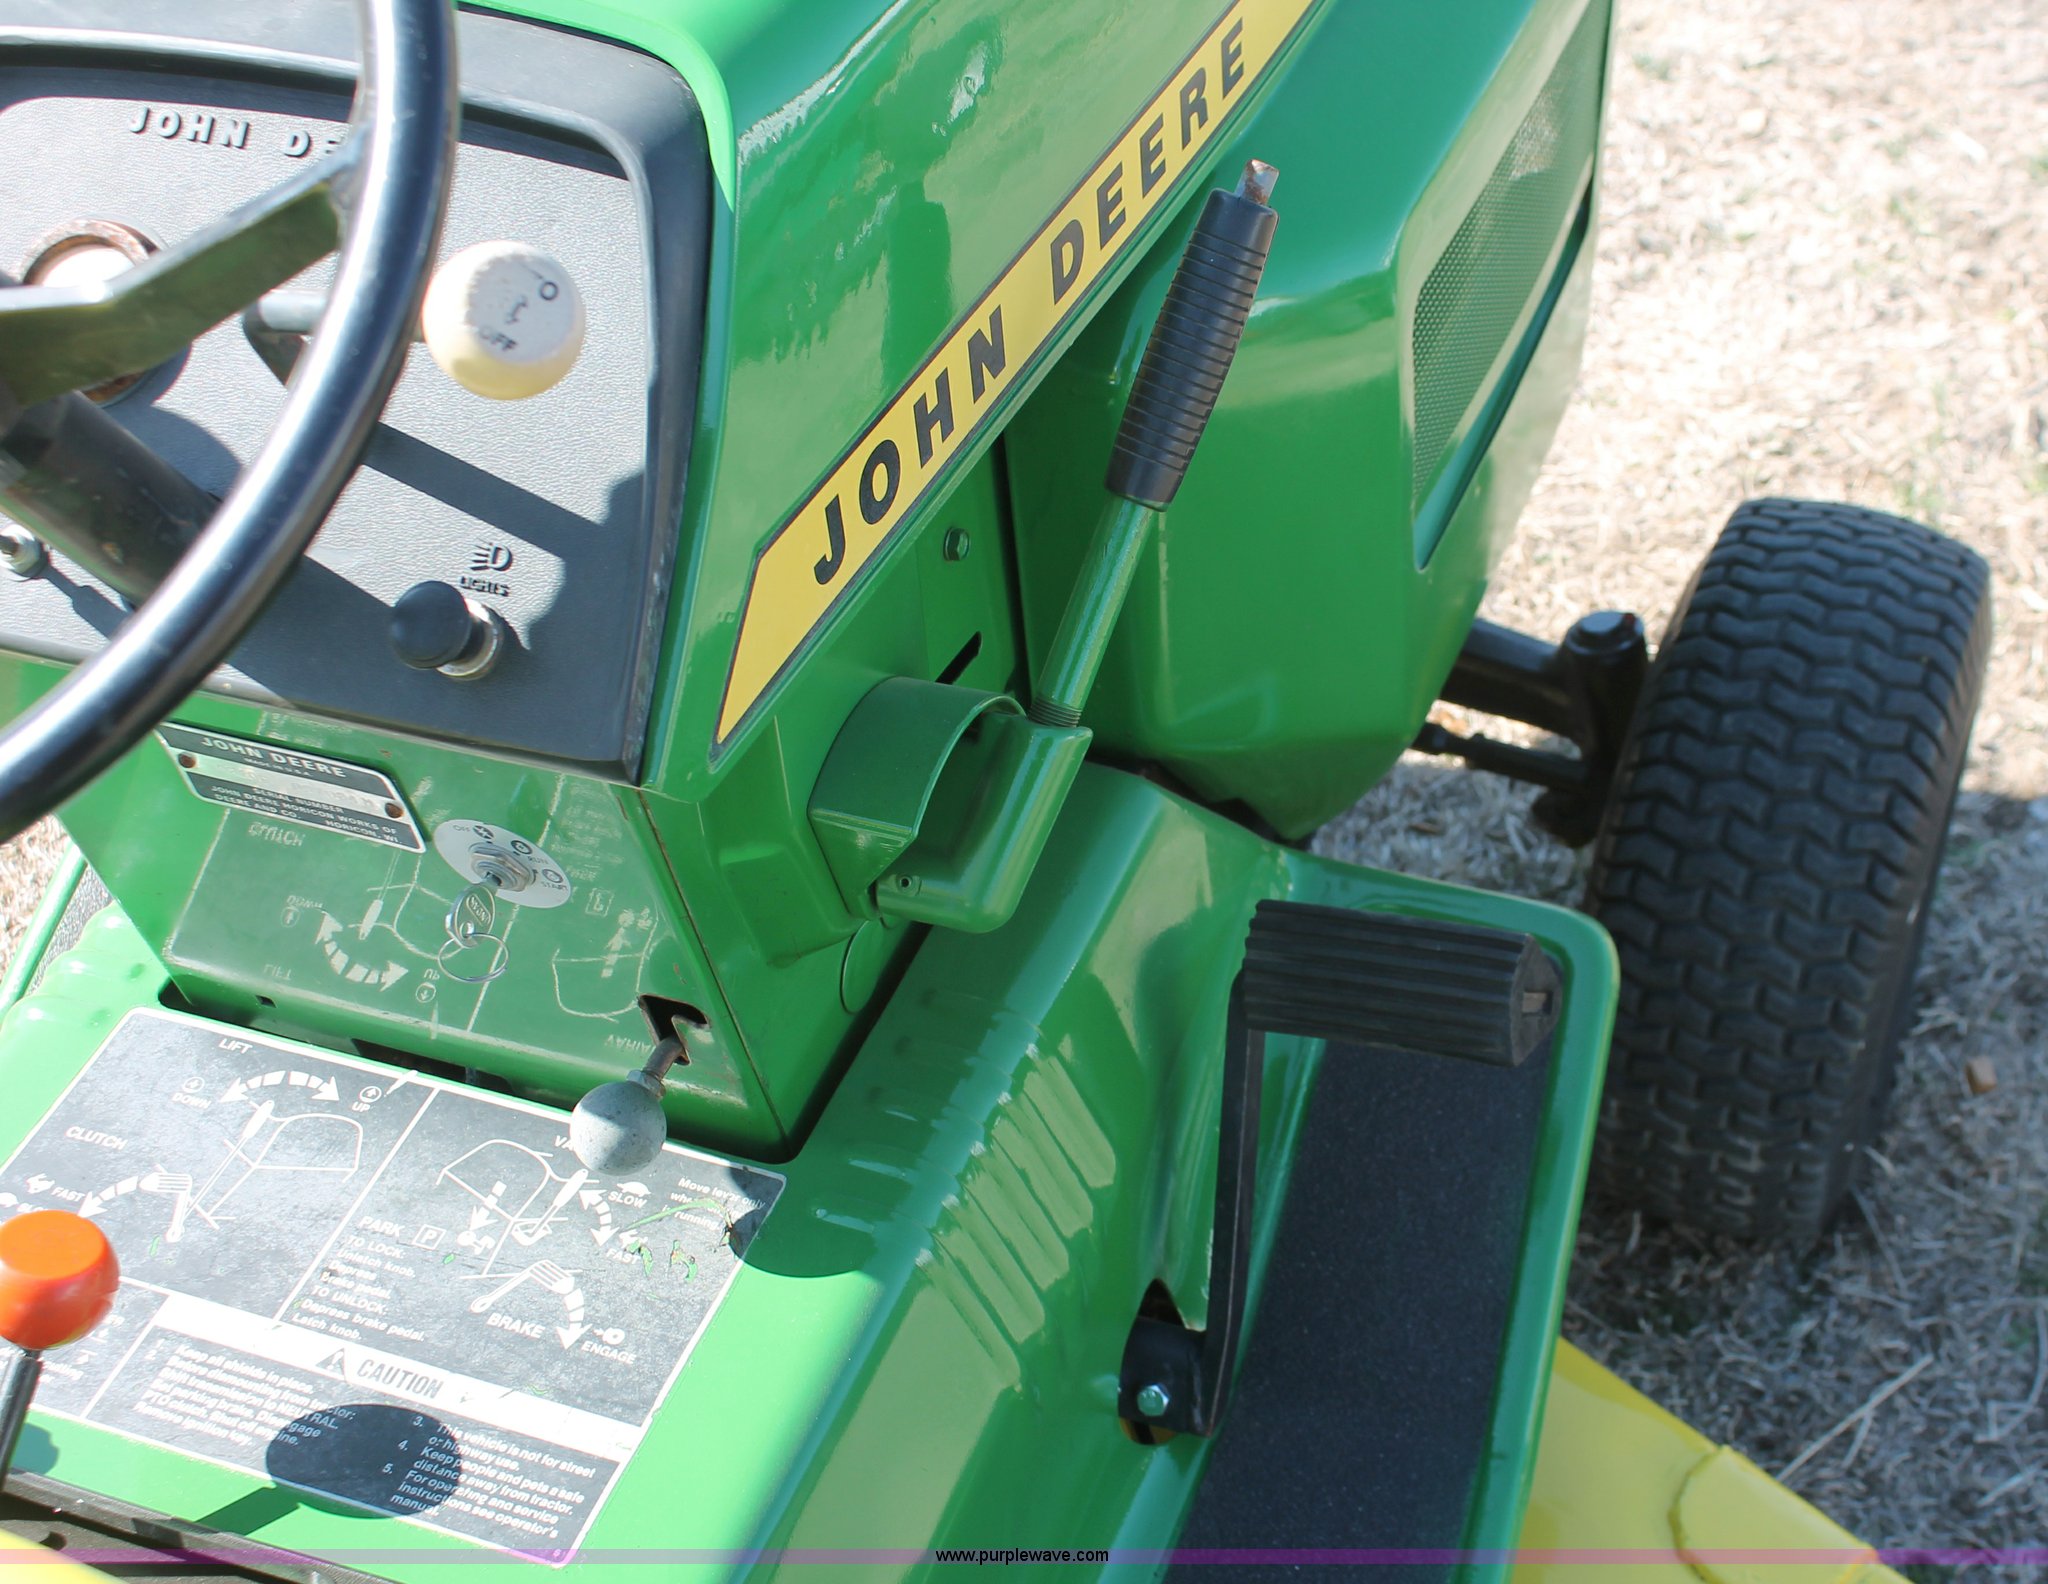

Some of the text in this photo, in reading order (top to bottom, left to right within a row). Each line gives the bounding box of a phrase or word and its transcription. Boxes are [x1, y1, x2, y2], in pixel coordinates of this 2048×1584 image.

[128, 106, 251, 149] JOHN
[814, 17, 1245, 585] JOHN DEERE
[201, 737, 346, 777] JOHN DEERE
[219, 1038, 252, 1054] LIFT
[172, 1093, 211, 1110] DOWN
[352, 1102, 370, 1113] UP
[65, 1126, 128, 1150] CLUTCH
[51, 1187, 86, 1202] FAST
[678, 1177, 712, 1194] Move
[608, 1191, 648, 1209] SLOW
[359, 1215, 405, 1237] PARK
[349, 1235, 406, 1258] TO LOCK:
[606, 1248, 641, 1265] FAST
[328, 1260, 377, 1280] Depress
[337, 1248, 416, 1278] Unlatch knob.
[311, 1285, 389, 1315] TO UNLOCK:
[354, 1282, 391, 1299] pedal.
[292, 1313, 362, 1340] Latch knob.
[301, 1298, 425, 1342] Depress brake pedal.
[486, 1312, 546, 1339] BRAKE
[175, 1344, 208, 1362] Keep
[580, 1340, 637, 1364] ENGAGE
[357, 1359, 444, 1399] CAUTION
[276, 1402, 338, 1430] NEUTRAL.
[413, 1416, 423, 1428] 3.
[437, 1422, 463, 1439] This
[463, 1431, 508, 1453] vehicle
[519, 1447, 542, 1462] not
[540, 1453, 561, 1468] for
[558, 1459, 597, 1479] street
[442, 1439, 497, 1464] highway
[495, 1456, 520, 1472] use.
[398, 1439, 409, 1452] 4.
[420, 1446, 454, 1466] Keep
[452, 1459, 498, 1478] people
[496, 1471, 523, 1486] and
[519, 1478, 550, 1495] pets
[557, 1488, 585, 1504] safe
[382, 1463, 393, 1474] 5.
[405, 1470, 429, 1484] For
[428, 1478, 489, 1505] operating
[513, 1504, 560, 1525] service
[413, 1459, 573, 1516] distance away from tractor.
[390, 1494, 440, 1517] manual.
[398, 1481, 559, 1539] instructions see operator's
